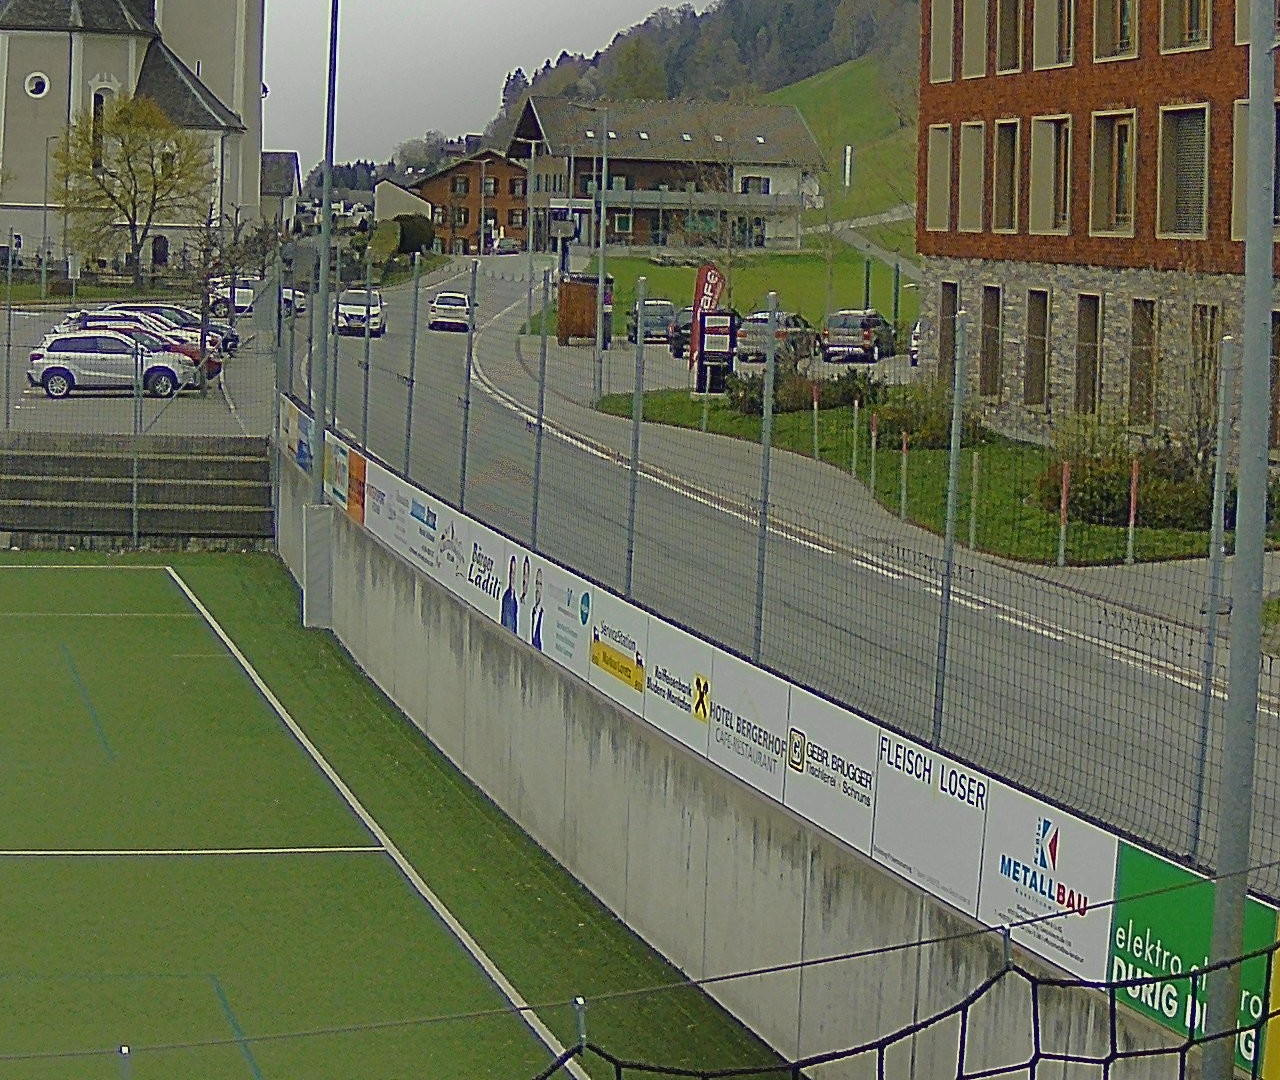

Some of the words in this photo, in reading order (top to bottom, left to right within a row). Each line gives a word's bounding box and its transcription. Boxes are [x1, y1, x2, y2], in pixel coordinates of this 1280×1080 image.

[655, 665, 692, 697] Raiffeisenbank
[709, 701, 734, 731] HOTEL
[736, 715, 787, 758] BERGERHOF
[806, 741, 829, 767] GEBR.
[831, 754, 873, 791] BRUGGER
[806, 760, 837, 788] Tischlerei
[842, 780, 871, 807] Schruns
[880, 736, 933, 785] FLEISCH
[940, 764, 986, 811] LOSER
[1000, 854, 1088, 917] METALLBAU
[1116, 919, 1182, 975] elektro
